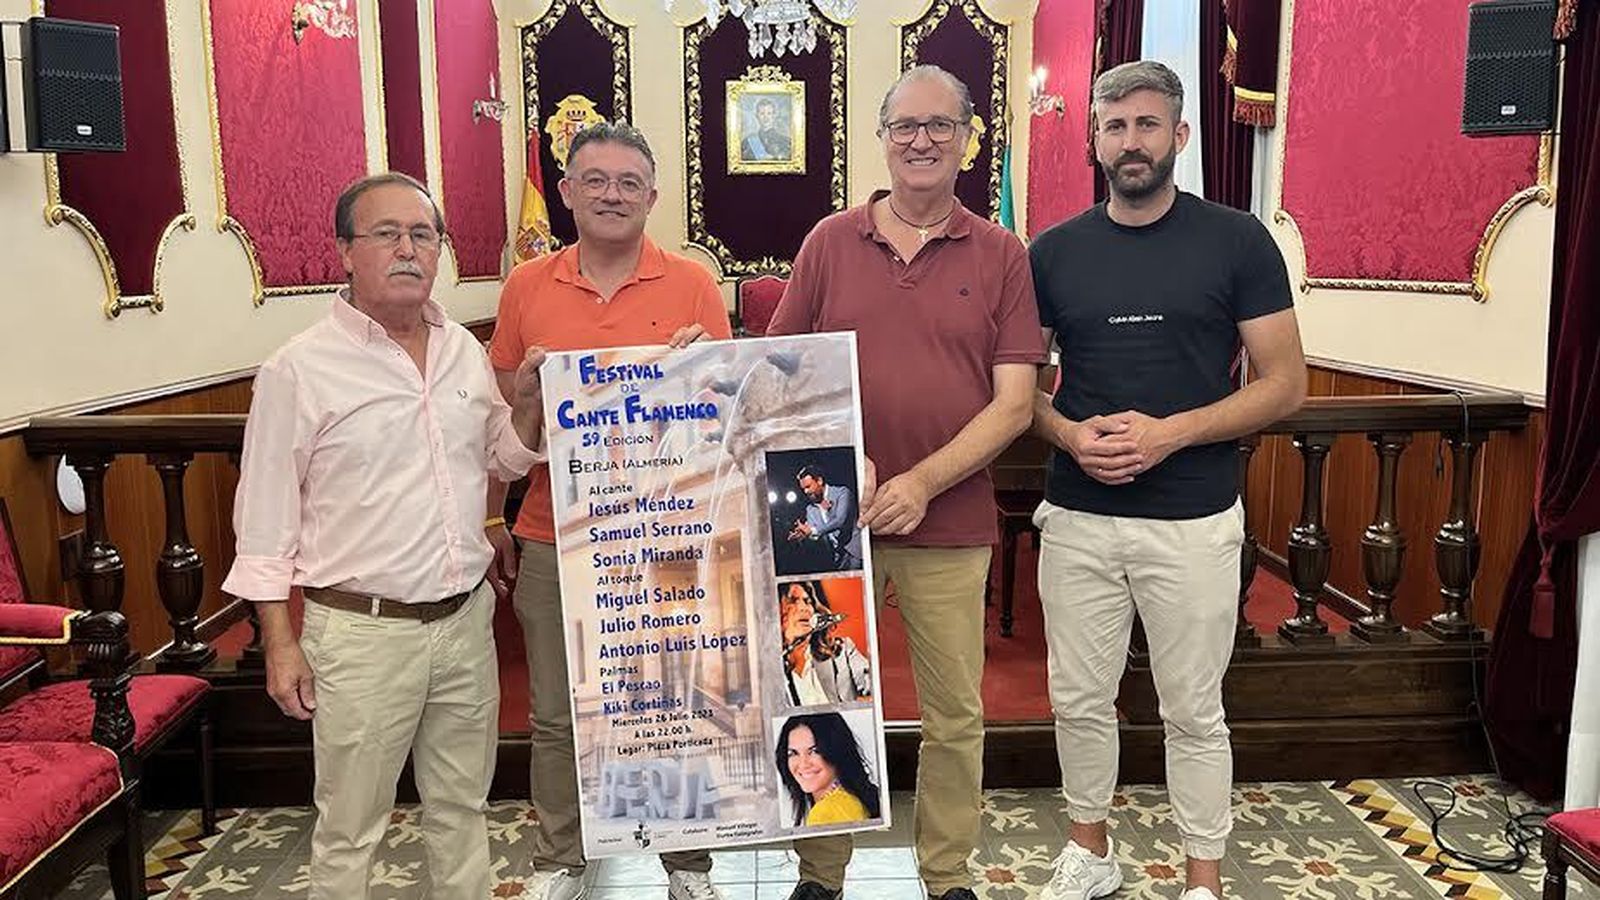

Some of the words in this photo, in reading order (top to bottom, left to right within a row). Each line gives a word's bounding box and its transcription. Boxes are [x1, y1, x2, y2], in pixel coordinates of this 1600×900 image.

[557, 400, 619, 429] CANTE
[625, 394, 718, 424] FLAMENCO
[582, 431, 600, 447] 59
[569, 458, 619, 474] BERJA
[602, 484, 633, 496] cante
[589, 500, 630, 518] Jesús
[635, 496, 695, 513] Méndez
[589, 523, 646, 543] Samuel
[652, 521, 713, 537] Serrano
[642, 545, 704, 563] Miranda
[611, 573, 643, 585] toque
[596, 589, 648, 612] Miguel
[654, 585, 705, 603] Salado
[601, 619, 636, 634] Julio
[642, 613, 701, 630] Romero
[600, 640, 660, 659] Antonio
[702, 633, 747, 652] López
[600, 665, 638, 677] Palmas
[602, 682, 614, 694] El
[619, 680, 660, 692] Pescao
[603, 700, 628, 715] Kiki
[656, 714, 667, 723] 26
[669, 712, 689, 721] Julio
[642, 730, 655, 738] las
